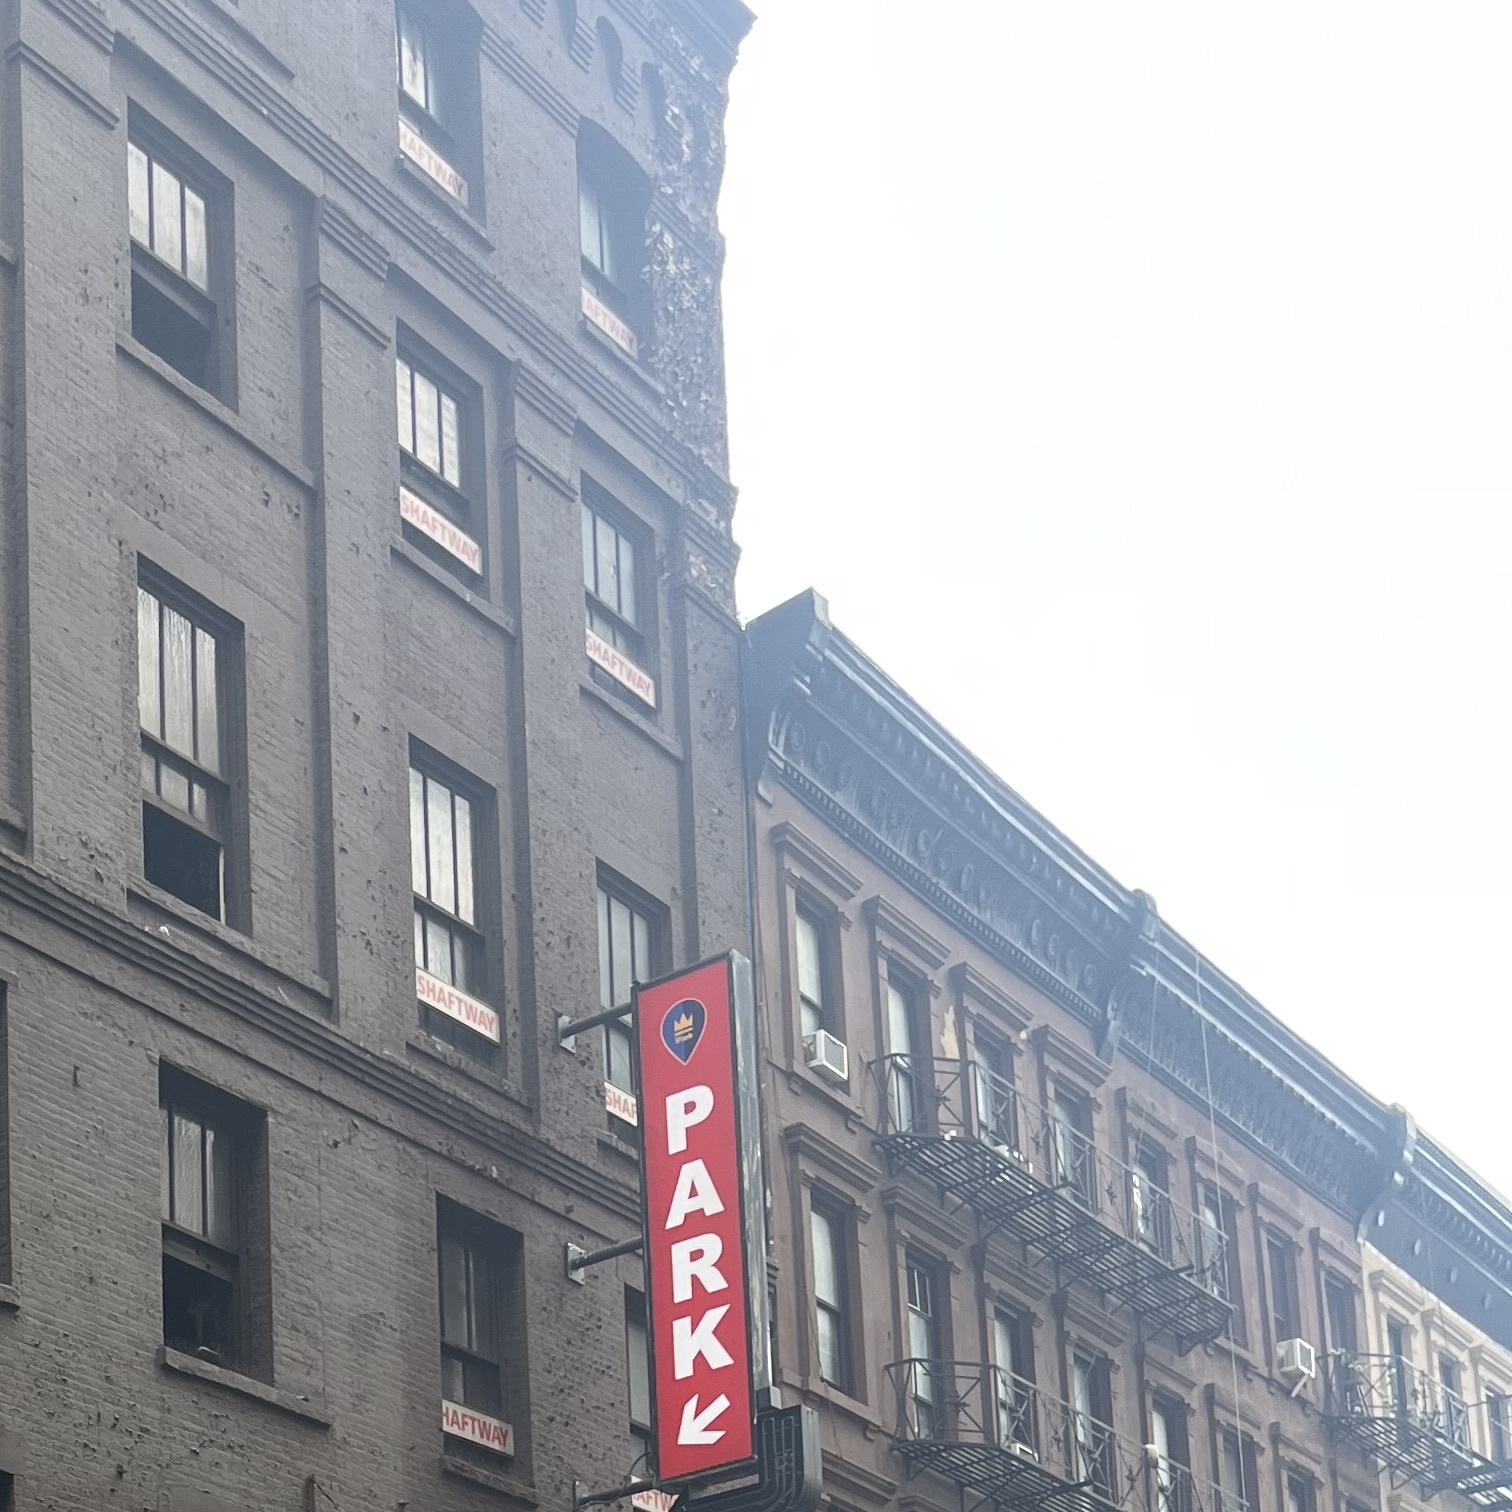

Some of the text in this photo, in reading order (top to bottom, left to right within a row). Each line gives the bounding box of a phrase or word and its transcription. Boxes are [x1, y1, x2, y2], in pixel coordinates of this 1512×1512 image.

[400, 493, 479, 565] SHAFTWAY
[586, 633, 652, 698] SHAFTWAY
[417, 975, 495, 1033] SHAFTWAY
[663, 1084, 736, 1379] PARK
